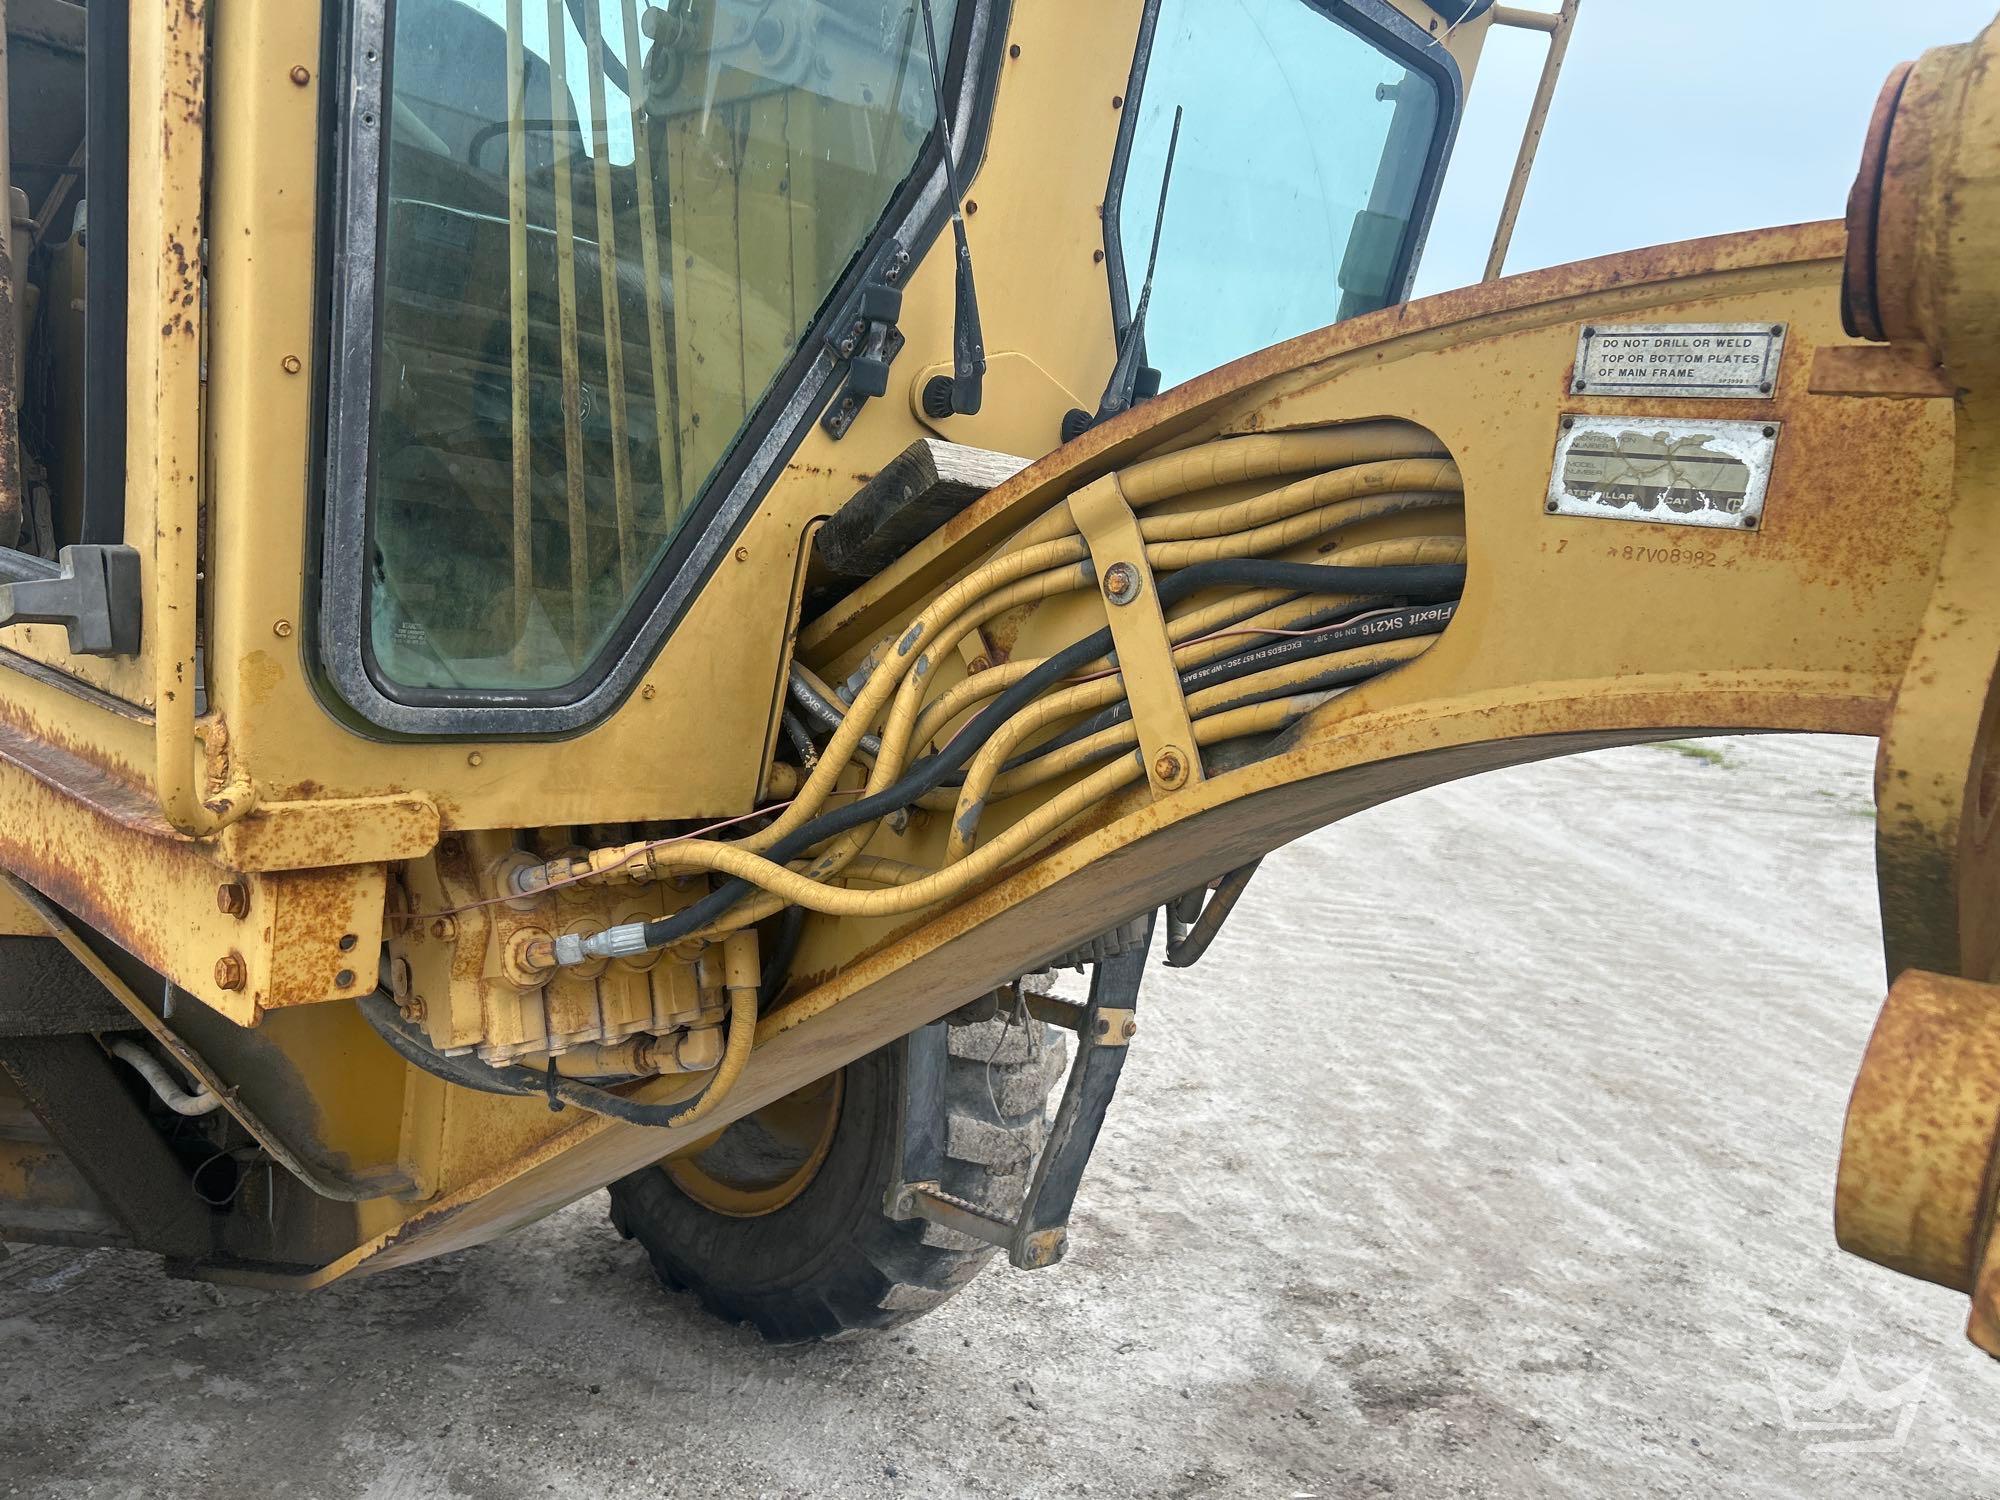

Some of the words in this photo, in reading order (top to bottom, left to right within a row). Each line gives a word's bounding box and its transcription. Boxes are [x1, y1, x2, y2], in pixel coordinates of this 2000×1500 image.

[1603, 339, 1619, 348] DO
[1623, 339, 1649, 348] NOT
[1654, 339, 1689, 348] DRILL
[1692, 339, 1710, 348] OR
[1716, 339, 1752, 348] WELD
[1601, 354, 1625, 363] TOP
[1627, 354, 1644, 363] OR
[1649, 354, 1703, 363] BOTTOM
[1707, 354, 1760, 364] PLATES
[1599, 368, 1615, 377] OF
[1618, 368, 1647, 377] MAIN
[1652, 368, 1695, 378] FRAME
[1566, 489, 1635, 501] ATERILLAR
[1665, 497, 1689, 505] CAT
[1409, 607, 1453, 625] Flexit
[1362, 617, 1404, 635] SK216
[1268, 641, 1302, 656] EXCEEDS
[1255, 650, 1267, 660] EN
[1211, 664, 1223, 673] WP
[1183, 673, 1198, 683] BAR
[821, 710, 842, 727] exit
